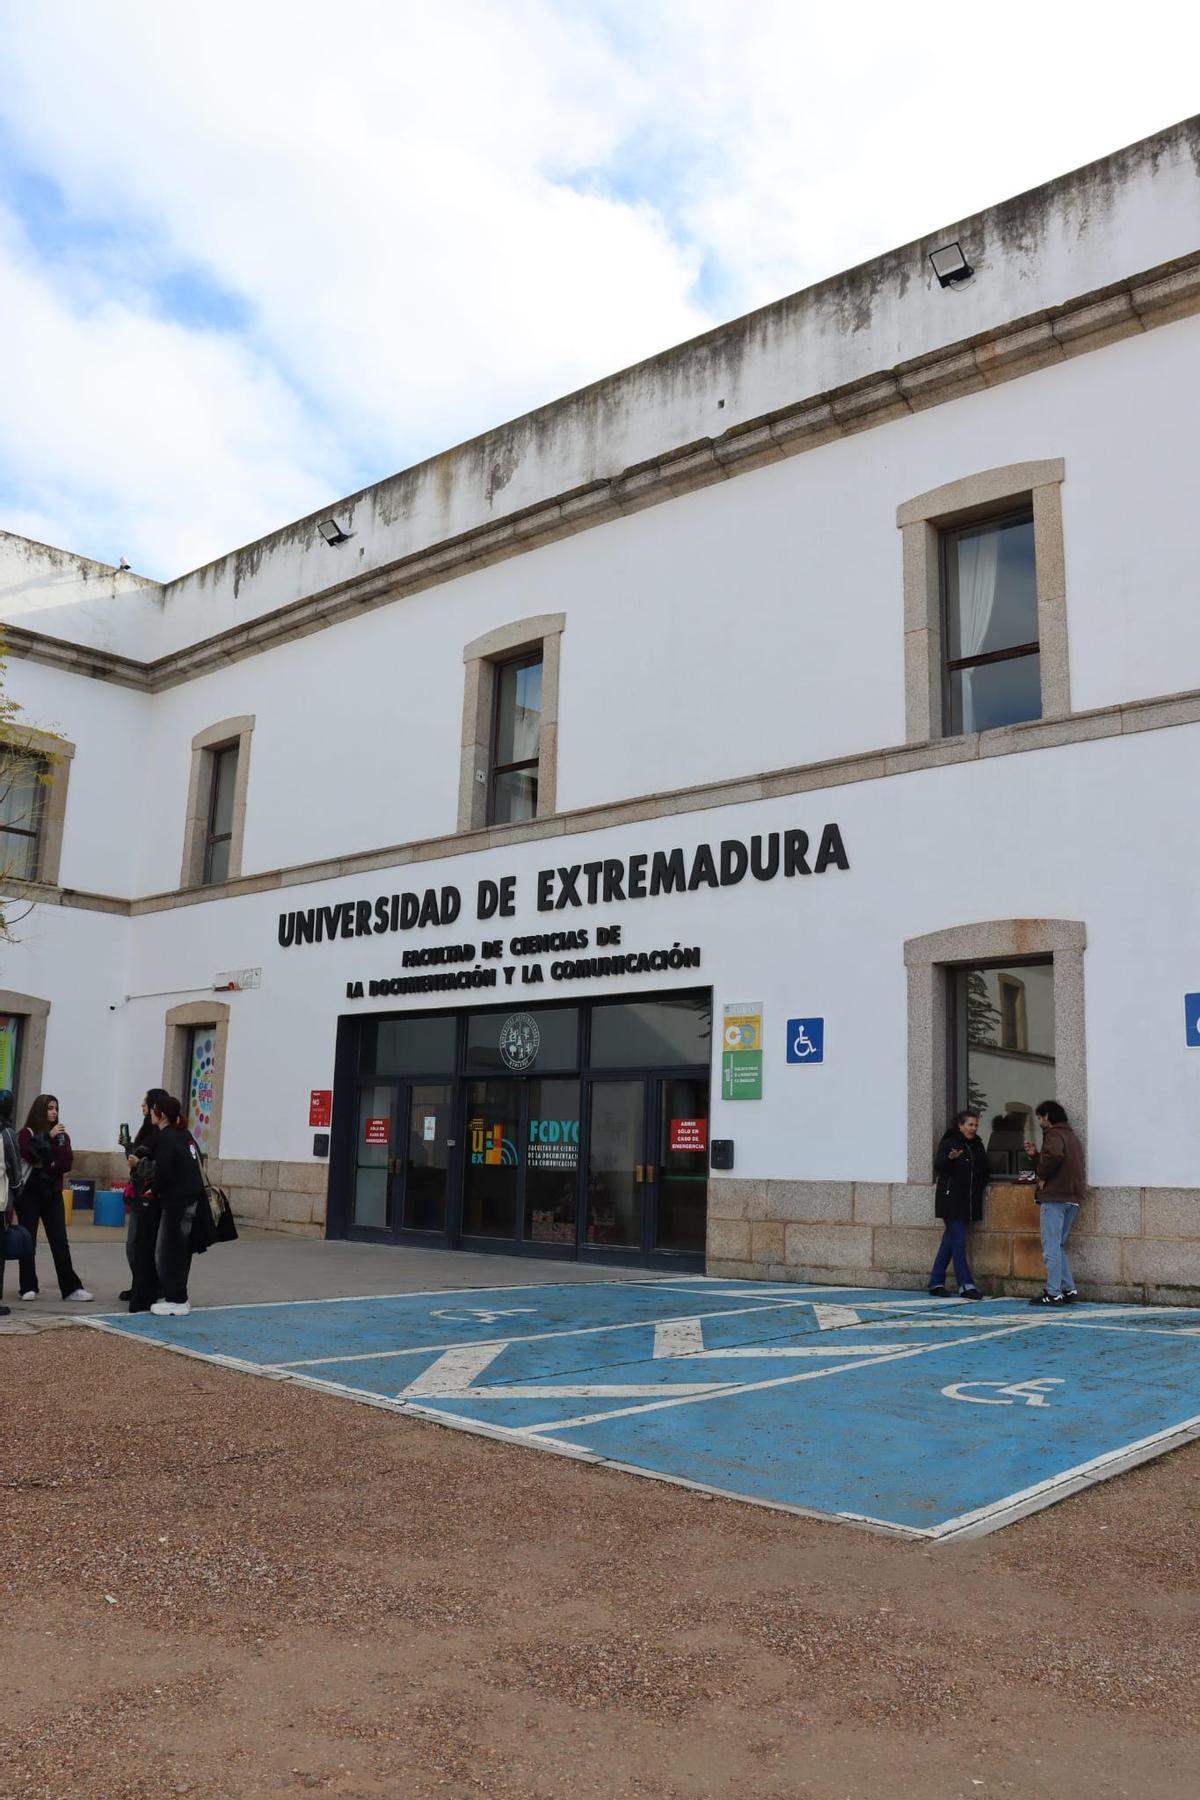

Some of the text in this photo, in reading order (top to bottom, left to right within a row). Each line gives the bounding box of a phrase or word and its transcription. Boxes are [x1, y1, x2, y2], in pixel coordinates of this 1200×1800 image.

[278, 823, 850, 948] UNIVERSIDAD DE EXTREMADURA
[346, 942, 701, 999] LA DOCUMENTACIÓN Y LA COMUNICACIÓN
[402, 925, 622, 968] FACULTAD DE CIENCIAS DE
[529, 1119, 580, 1143] FCDYC
